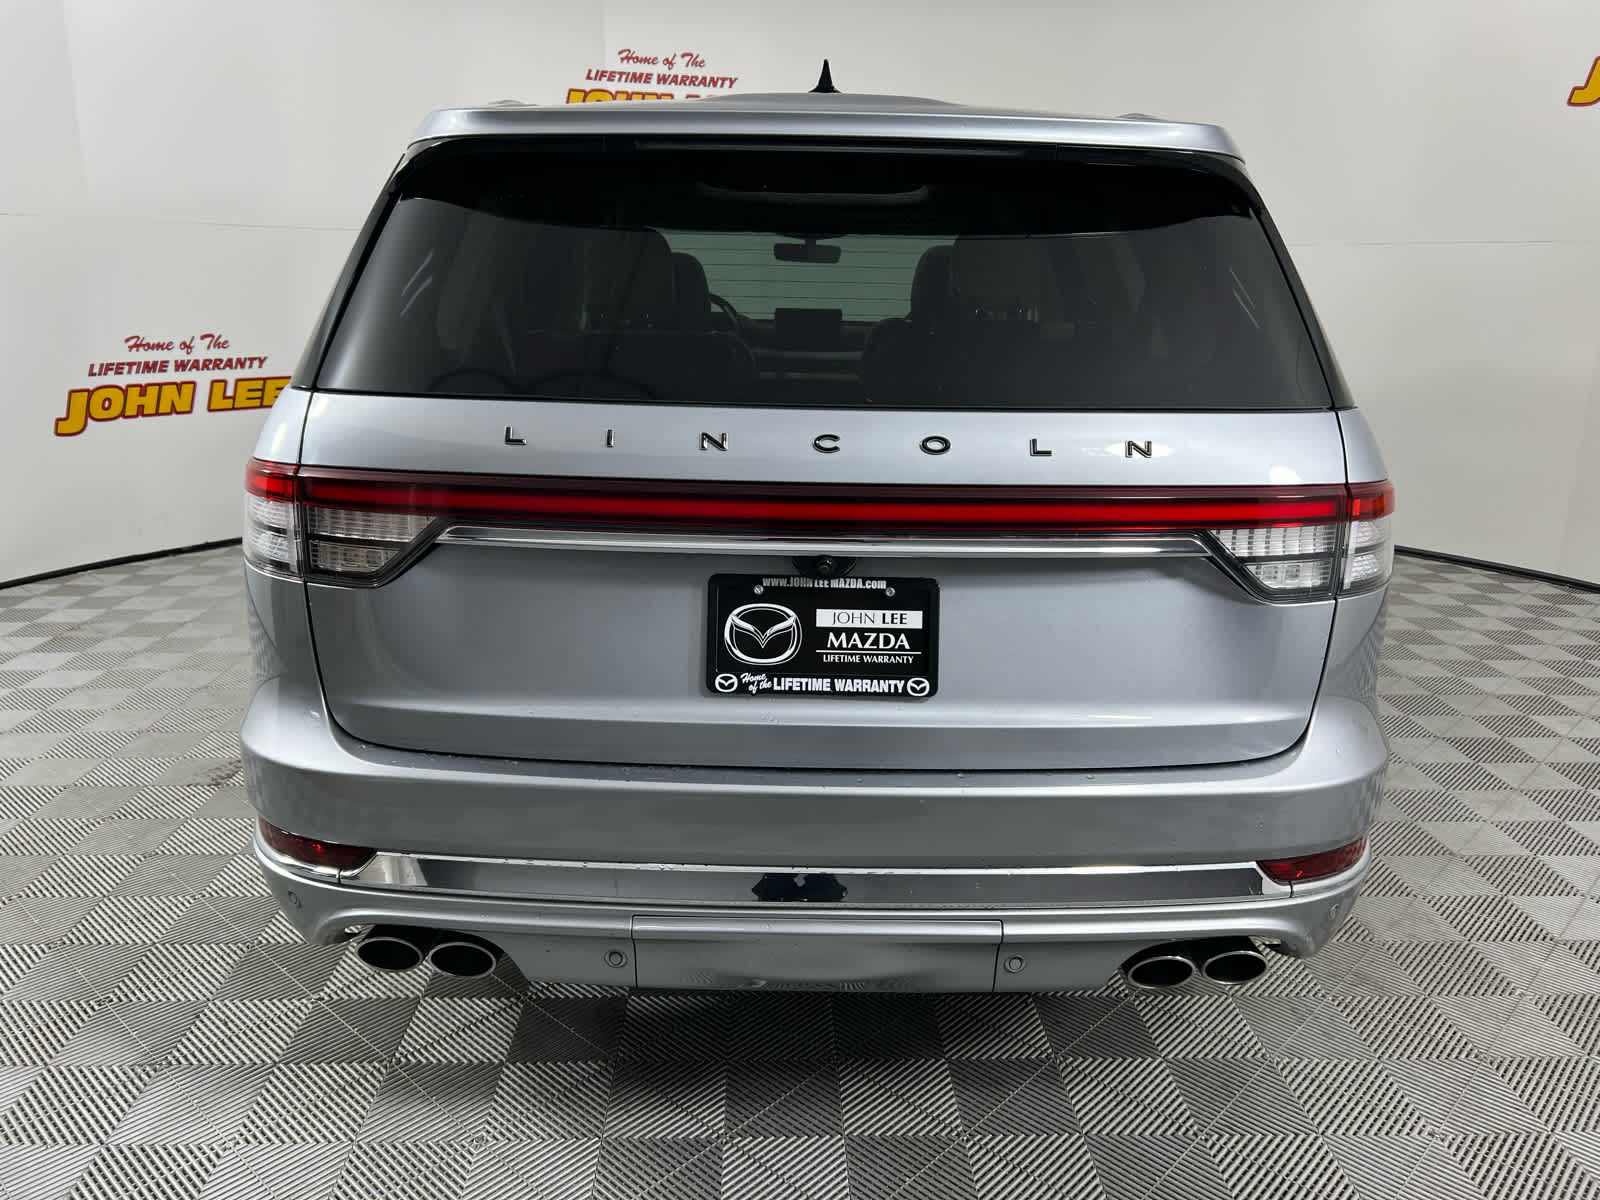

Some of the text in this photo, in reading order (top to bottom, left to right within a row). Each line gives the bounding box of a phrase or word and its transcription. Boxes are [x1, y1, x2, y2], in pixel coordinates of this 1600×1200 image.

[618, 49, 706, 70] Home of The
[586, 69, 738, 89] LIFETIME WARRANTY
[125, 333, 230, 354] Home of The
[88, 356, 268, 377] LIFETIME WARRANTY
[54, 381, 196, 436] JOHN
[504, 425, 1152, 458] LINCOLN
[814, 579, 829, 588] LEE
[830, 578, 887, 590] MAZDA.com
[832, 612, 908, 625] JOHN LEE
[827, 632, 911, 649] MAZDA
[823, 654, 914, 664] LIFETIME WARRANTY
[740, 673, 767, 684] Home
[749, 677, 904, 694] of the LIFETIME WARRANTY
